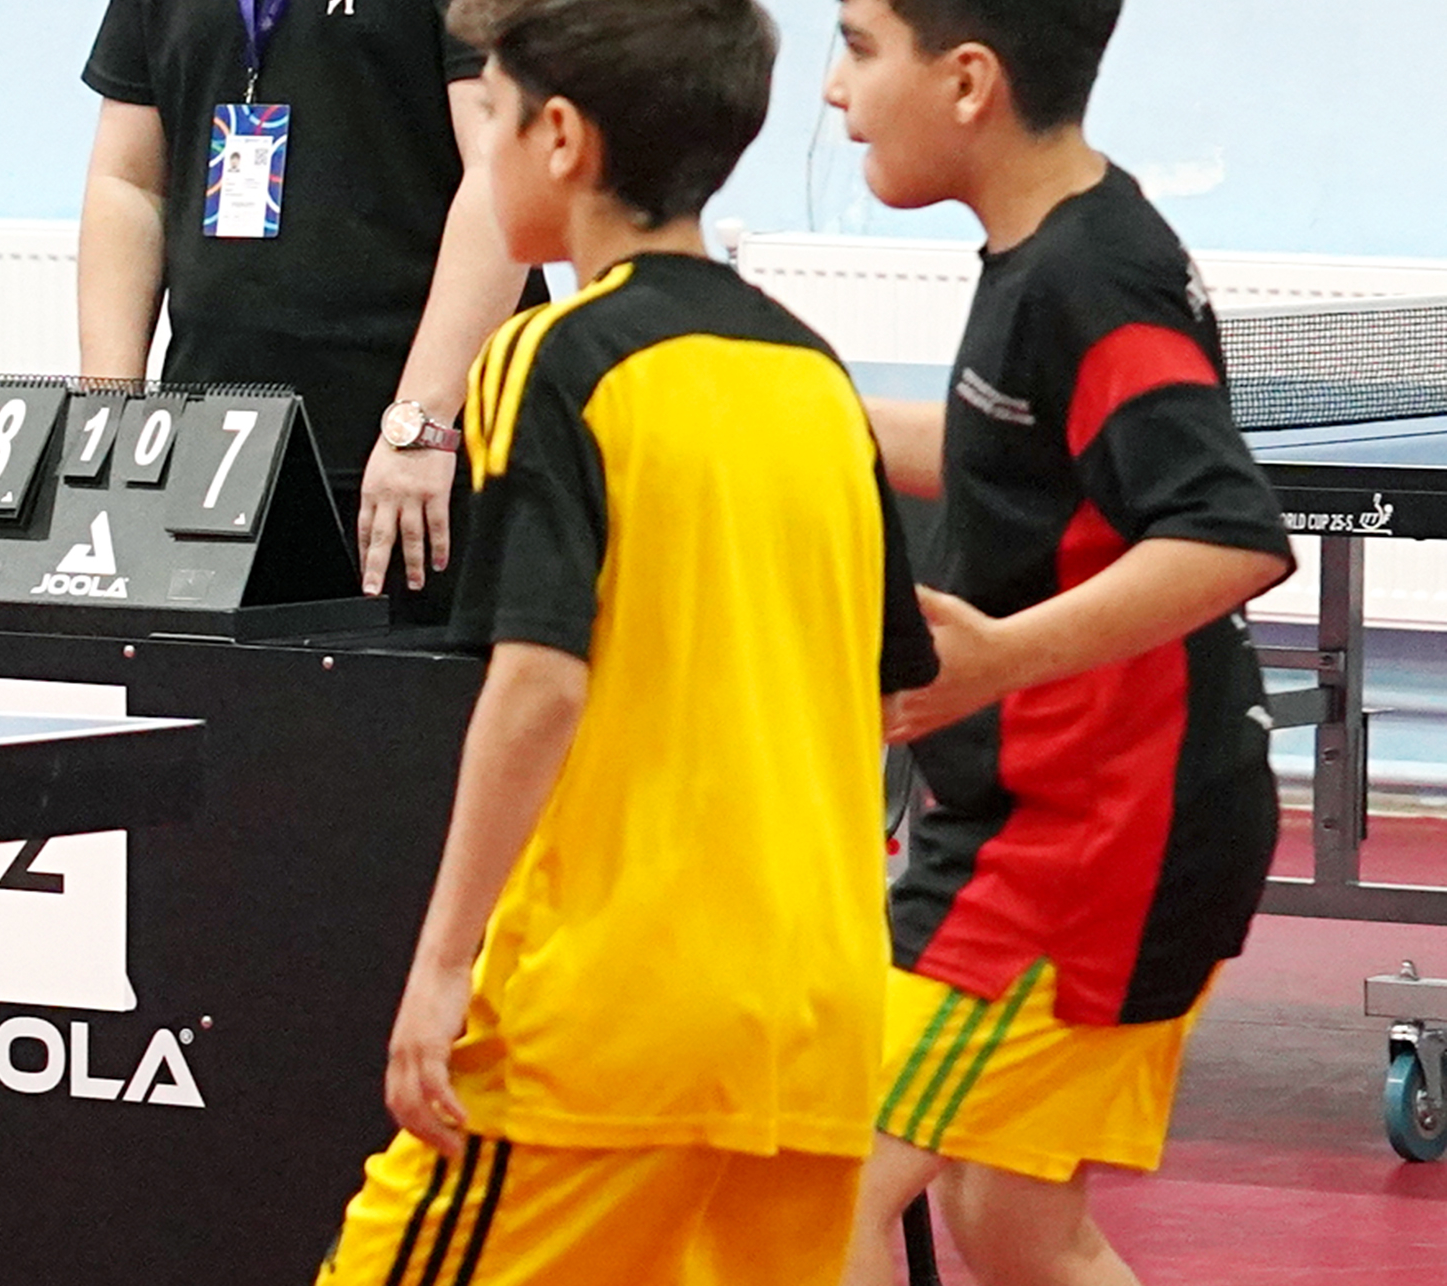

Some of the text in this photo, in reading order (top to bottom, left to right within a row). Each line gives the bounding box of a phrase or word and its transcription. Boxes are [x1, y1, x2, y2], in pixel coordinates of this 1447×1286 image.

[80, 407, 110, 461] 1
[134, 409, 172, 465] 0
[203, 410, 258, 508] 7
[1308, 514, 1329, 530] CUP
[30, 574, 128, 598] JOOLA
